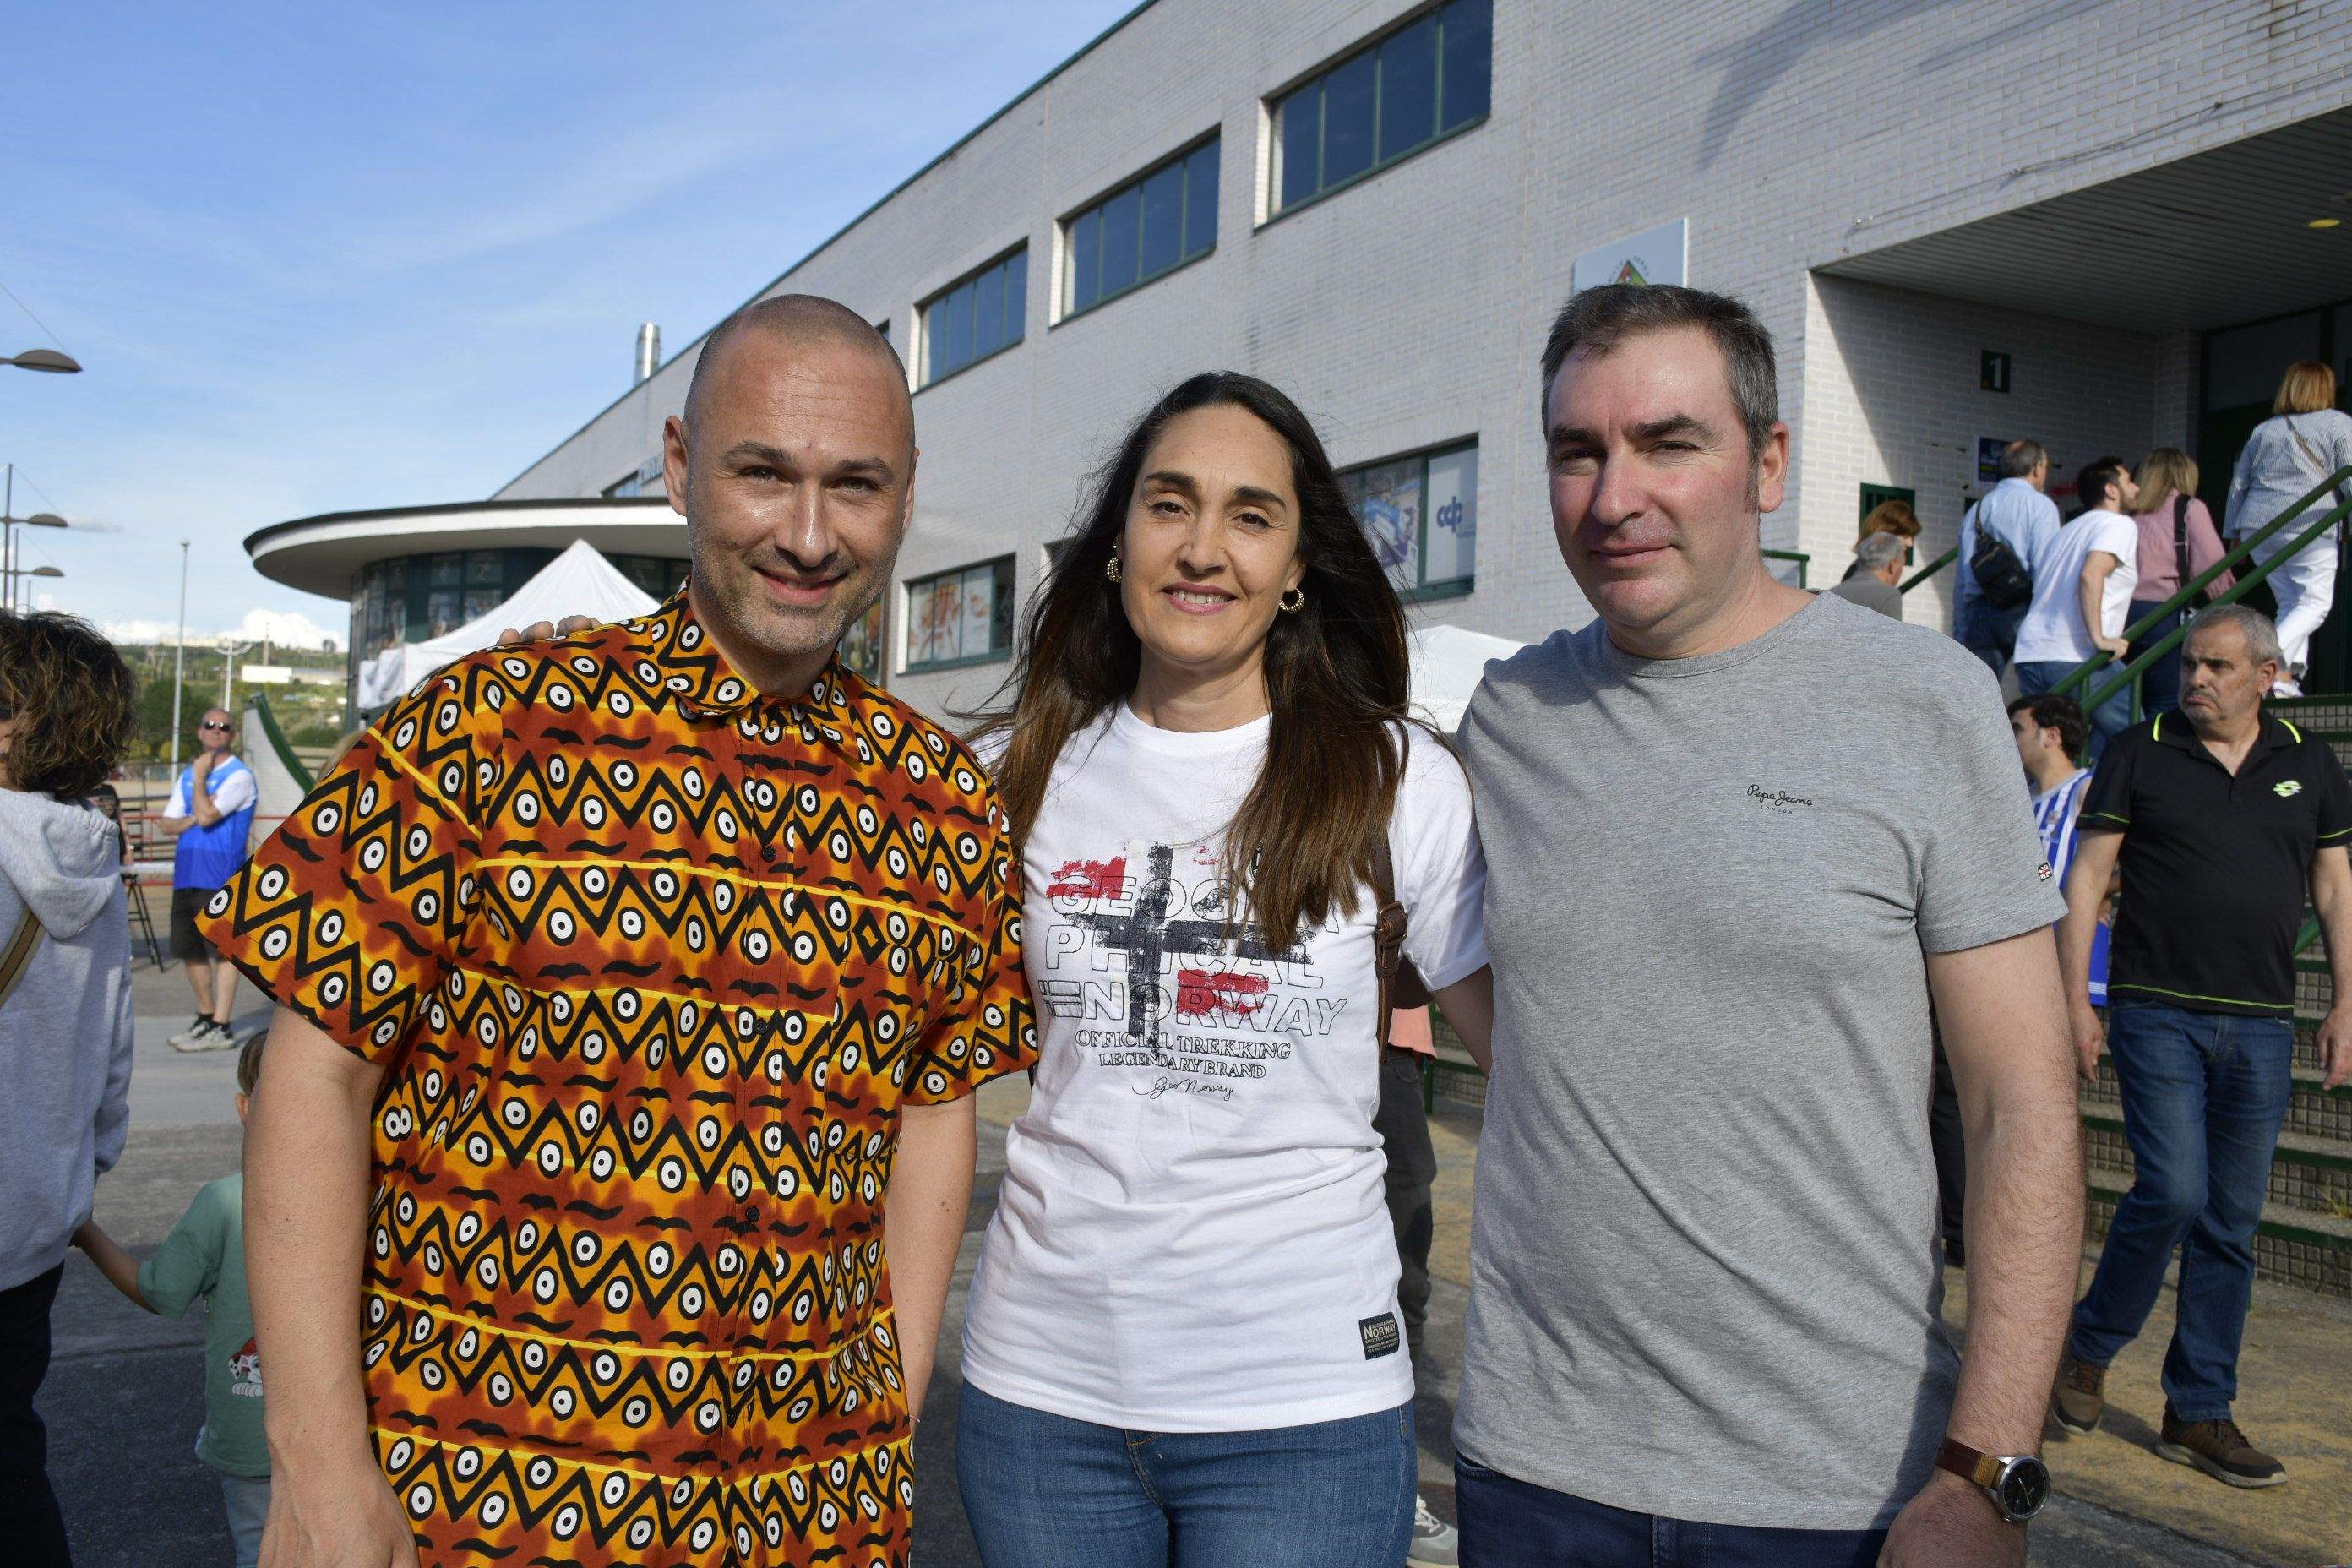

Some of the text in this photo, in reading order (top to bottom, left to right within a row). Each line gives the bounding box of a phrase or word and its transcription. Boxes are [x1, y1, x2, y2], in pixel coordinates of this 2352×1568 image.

[1990, 356, 2003, 389] 1
[1746, 784, 1775, 803] Pepe
[1075, 1029, 1292, 1059] OFFICIAL TREKKING
[1098, 1053, 1266, 1079] LEGENDARY BRAND
[1363, 1322, 1396, 1340] NORWAY
